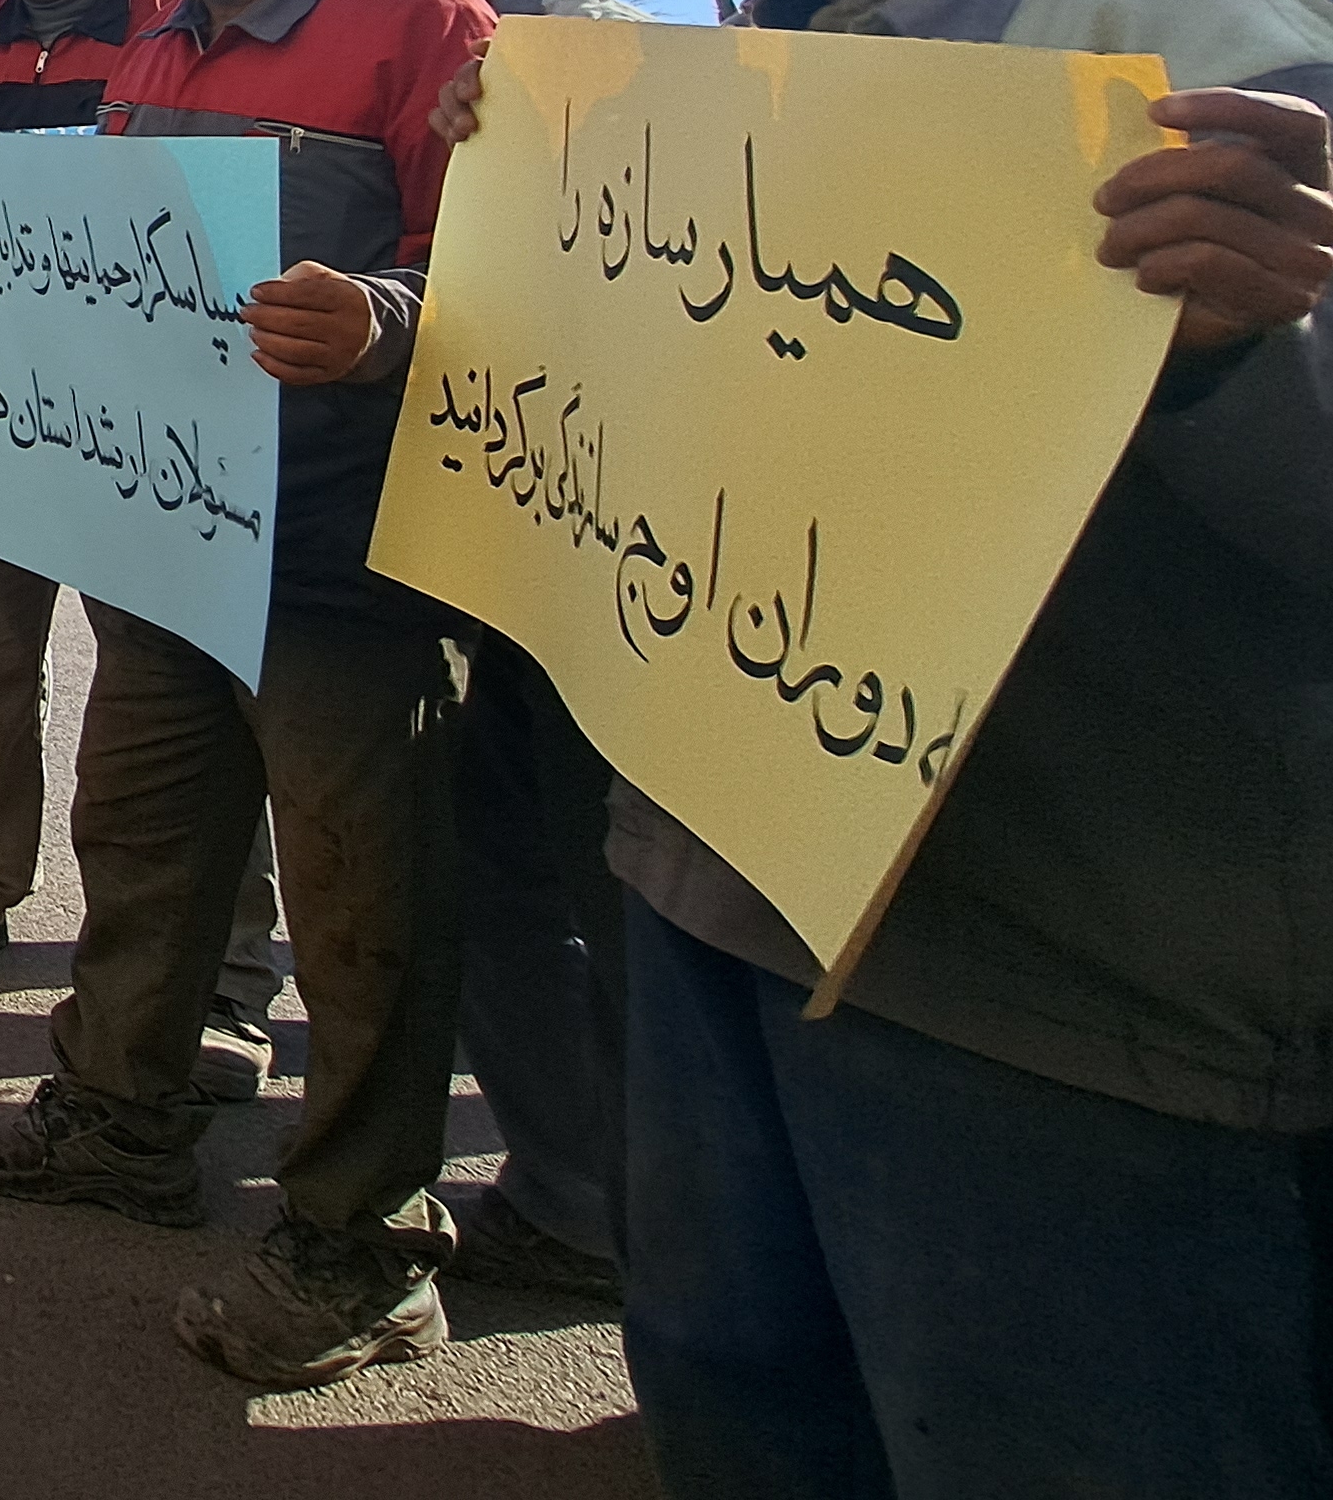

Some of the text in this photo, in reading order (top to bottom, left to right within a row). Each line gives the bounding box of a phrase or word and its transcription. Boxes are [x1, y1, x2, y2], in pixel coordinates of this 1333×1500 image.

[30, 252, 51, 296] و
[559, 98, 963, 361] همیار سازه را
[9, 366, 81, 449] استان
[80, 404, 147, 500] ارشد
[545, 383, 619, 549] سازندگی
[616, 487, 725, 663] اوج
[728, 518, 916, 764] دوران
